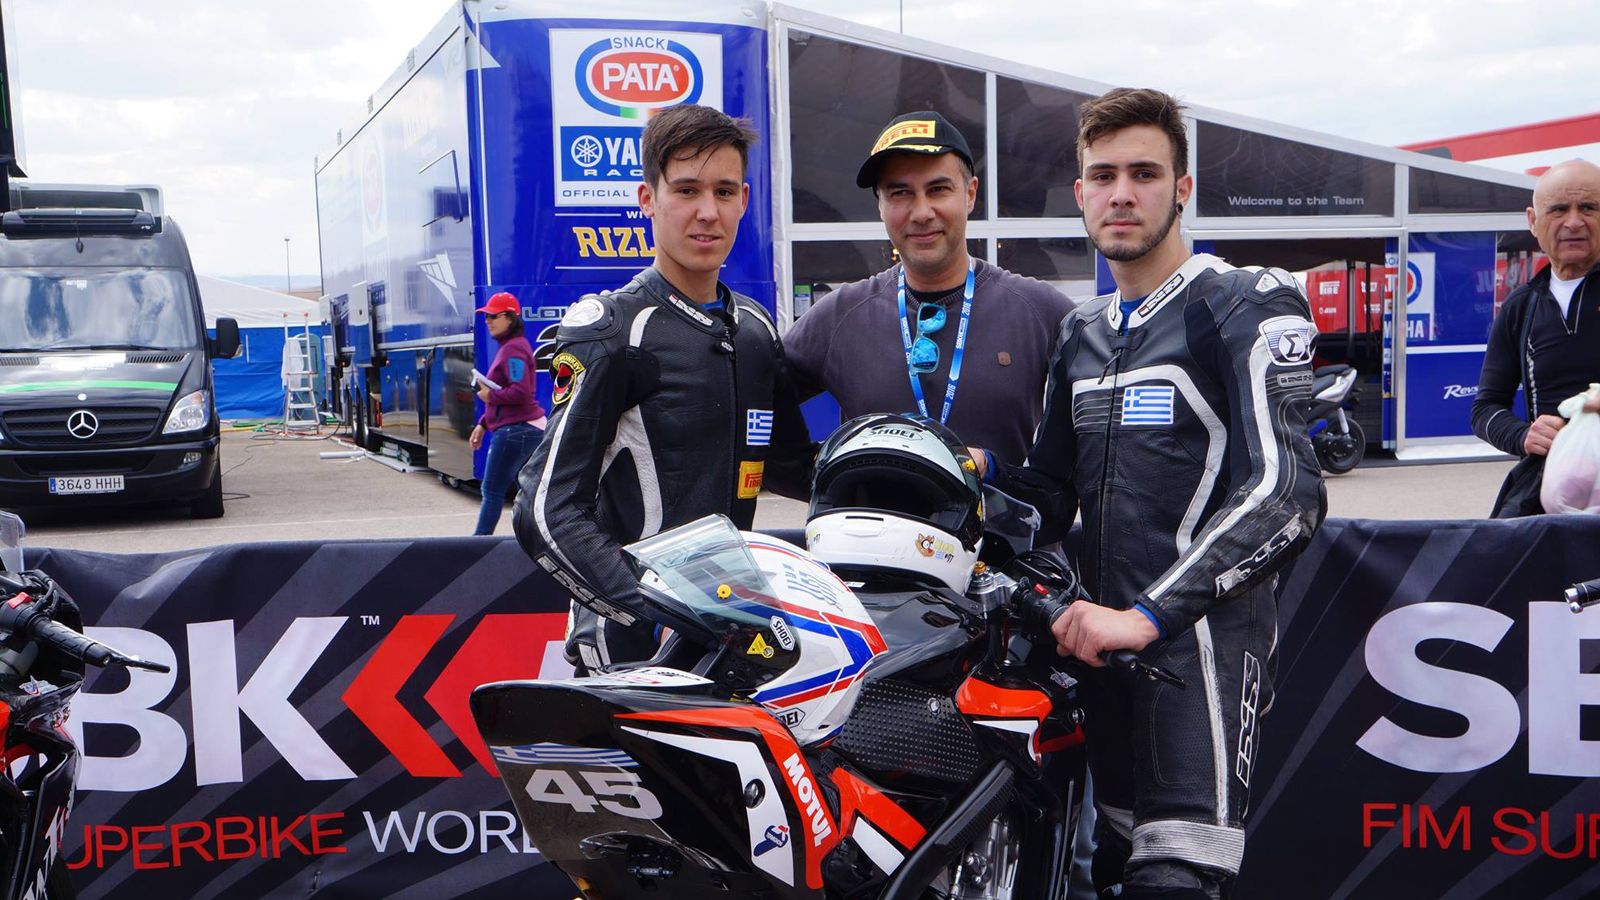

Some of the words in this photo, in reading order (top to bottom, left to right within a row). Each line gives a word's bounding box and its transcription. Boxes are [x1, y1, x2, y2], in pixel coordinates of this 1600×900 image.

[613, 37, 665, 50] SNACK
[602, 62, 679, 92] PATA
[583, 168, 644, 177] RAC
[562, 189, 630, 198] OFFICIAL
[1228, 195, 1283, 206] Welcome
[1288, 197, 1302, 206] to
[1307, 195, 1328, 206] the
[1332, 195, 1364, 206] Team
[572, 226, 656, 257] RIZL
[58, 479, 92, 491] 3648
[95, 477, 121, 489] HHH
[773, 620, 792, 647] SHOEI
[66, 615, 359, 793] BK
[525, 769, 664, 820] 45
[783, 753, 832, 848] MOTUL
[67, 811, 348, 870] UPERBIKE
[363, 810, 545, 855] WORL
[1362, 802, 1472, 851] FIM
